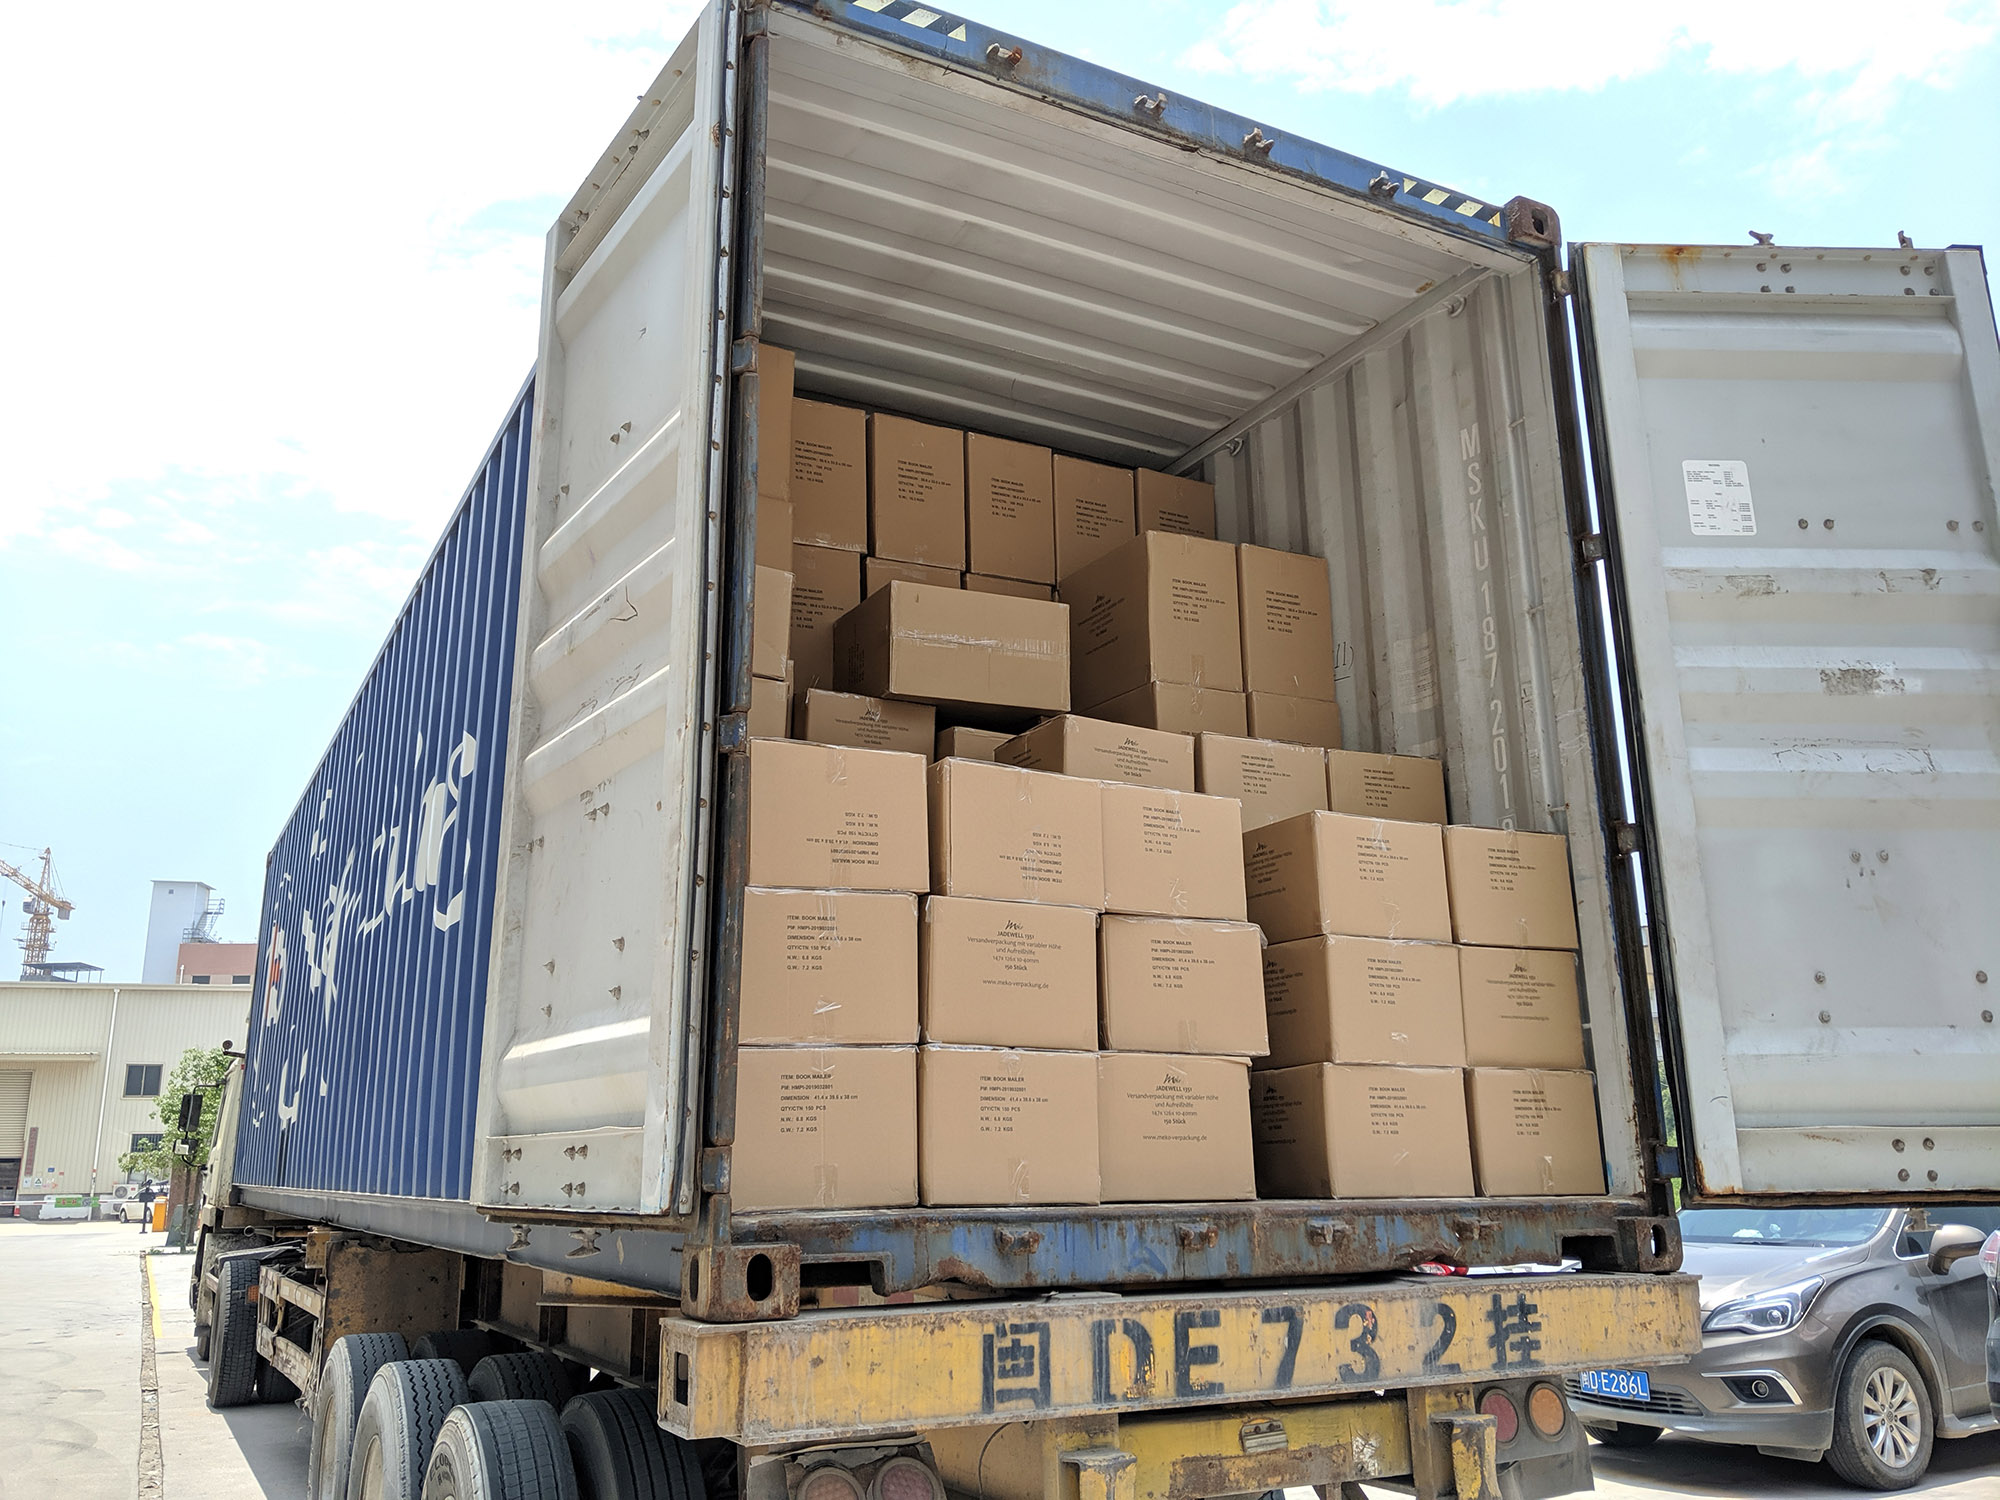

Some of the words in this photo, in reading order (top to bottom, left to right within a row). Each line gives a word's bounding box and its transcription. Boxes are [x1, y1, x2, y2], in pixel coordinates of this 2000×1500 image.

[997, 931, 1024, 939] JADEWELL
[967, 936, 1017, 947] Versandverpackung
[1007, 948, 1035, 956] Aufreißhilfe
[982, 979, 1049, 990] www.meko-verpackung.de
[1127, 1093, 1175, 1101] Versandverpackung
[1142, 1134, 1207, 1142] www.meko-verpackung.de
